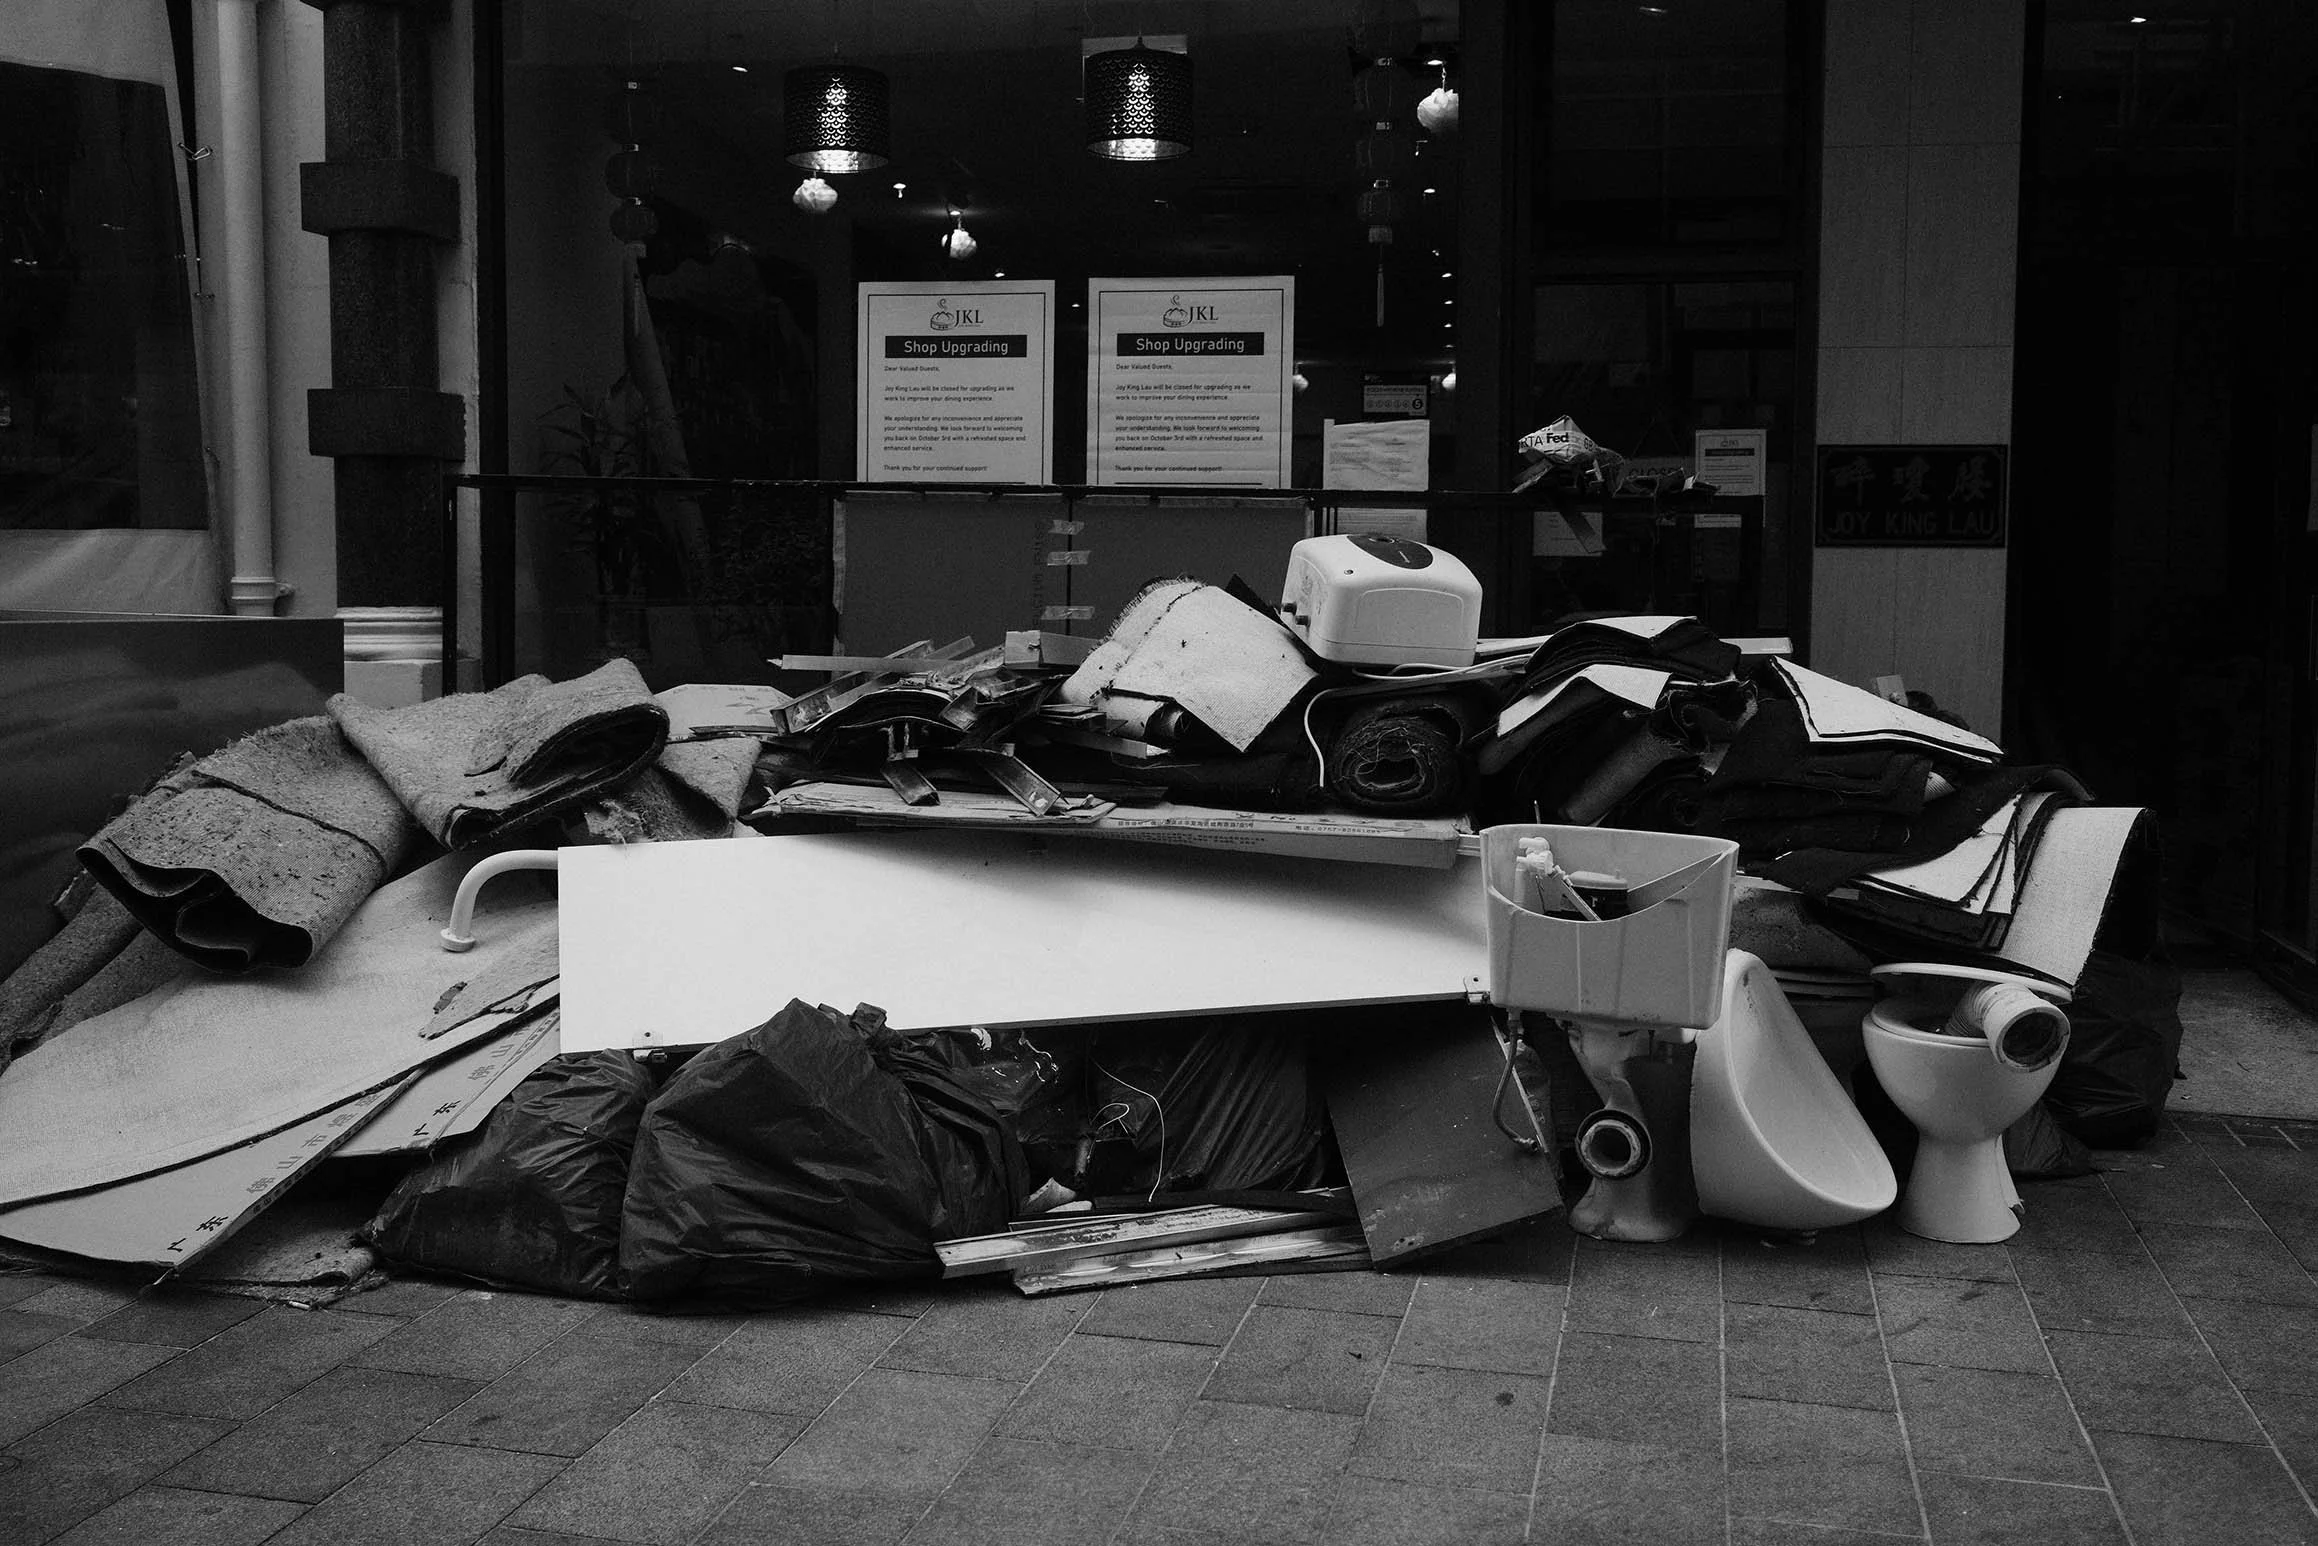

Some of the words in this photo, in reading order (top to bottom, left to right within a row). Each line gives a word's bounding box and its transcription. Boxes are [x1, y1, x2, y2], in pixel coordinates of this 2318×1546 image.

[954, 309, 984, 327] JKL
[1188, 306, 1219, 324] JKL
[904, 339, 937, 356] Shop
[941, 339, 1009, 356] Upgrading
[1136, 337, 1170, 354] Shop
[1174, 337, 1245, 354] Upgrading
[1827, 509, 1873, 536] JOY
[1885, 509, 1938, 536] KING
[1946, 509, 1995, 536] LAU
[168, 1216, 228, 1252] 广东
